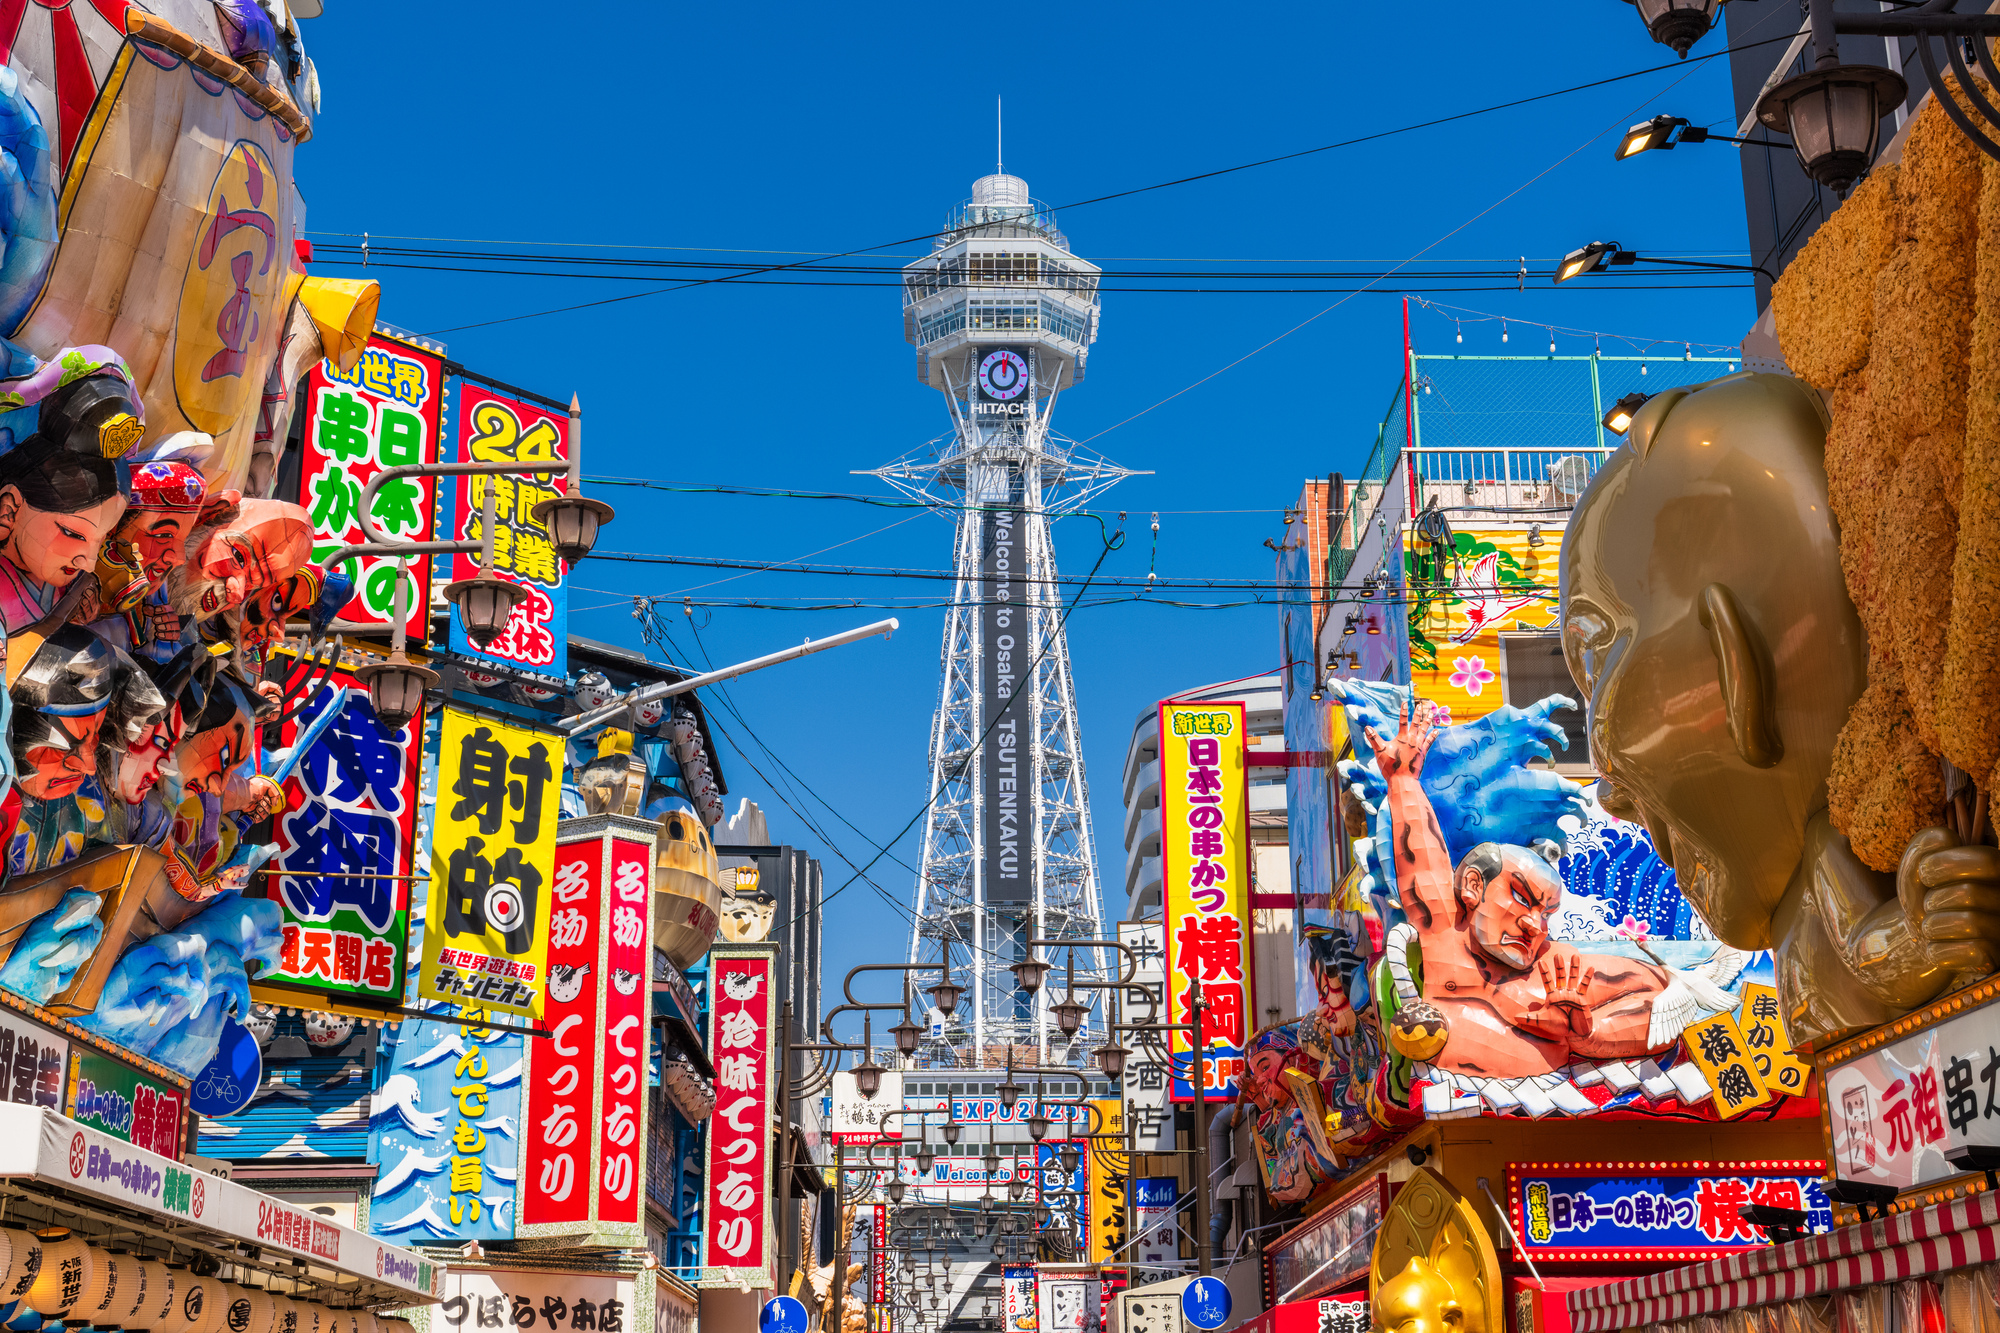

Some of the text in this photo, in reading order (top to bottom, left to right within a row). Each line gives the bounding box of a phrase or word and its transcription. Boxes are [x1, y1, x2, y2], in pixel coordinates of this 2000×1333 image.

[470, 403, 559, 483] 24
[971, 402, 1036, 415] HITACHI
[365, 407, 423, 618] 日本の
[995, 511, 1019, 880] Welcome to Osaka TSUTENKAKU!
[1173, 712, 1231, 735] 新世界
[281, 681, 405, 931] 横綱
[443, 725, 553, 955] 射的
[1187, 737, 1225, 913] 日本一の串かつ
[278, 925, 396, 989] 通天閣店
[434, 968, 536, 1009] チャンピオン
[438, 947, 537, 981] 新世界遊技場
[1176, 914, 1245, 1048] 横綱
[539, 859, 590, 1203] 名物 てっちり
[603, 860, 645, 1202] 名物 てっちり
[1124, 935, 1171, 1140] 半田屋酒店
[1697, 1022, 1759, 1109] 横綱
[1747, 993, 1778, 1078] 串かつ
[76, 1078, 179, 1161] 日本一の串かつ 横綱
[715, 1008, 760, 1260] 珍味てっちり
[86, 1144, 192, 1215] 日本一の串かつ 横綱
[936, 1163, 998, 1181] Welcome
[999, 1167, 1011, 1180] to
[1136, 1185, 1173, 1204] Asahi
[257, 1199, 312, 1253] 24時間営業
[1528, 1179, 1833, 1242] 新世界 日本一の串かつ 横綱 名門
[59, 1267, 82, 1309] 新世界
[60, 1256, 82, 1271] 大阪
[384, 1252, 418, 1284] 日本一の串かつ
[283, 1309, 298, 1333] 横
[441, 1292, 626, 1333] づぼらや本店
